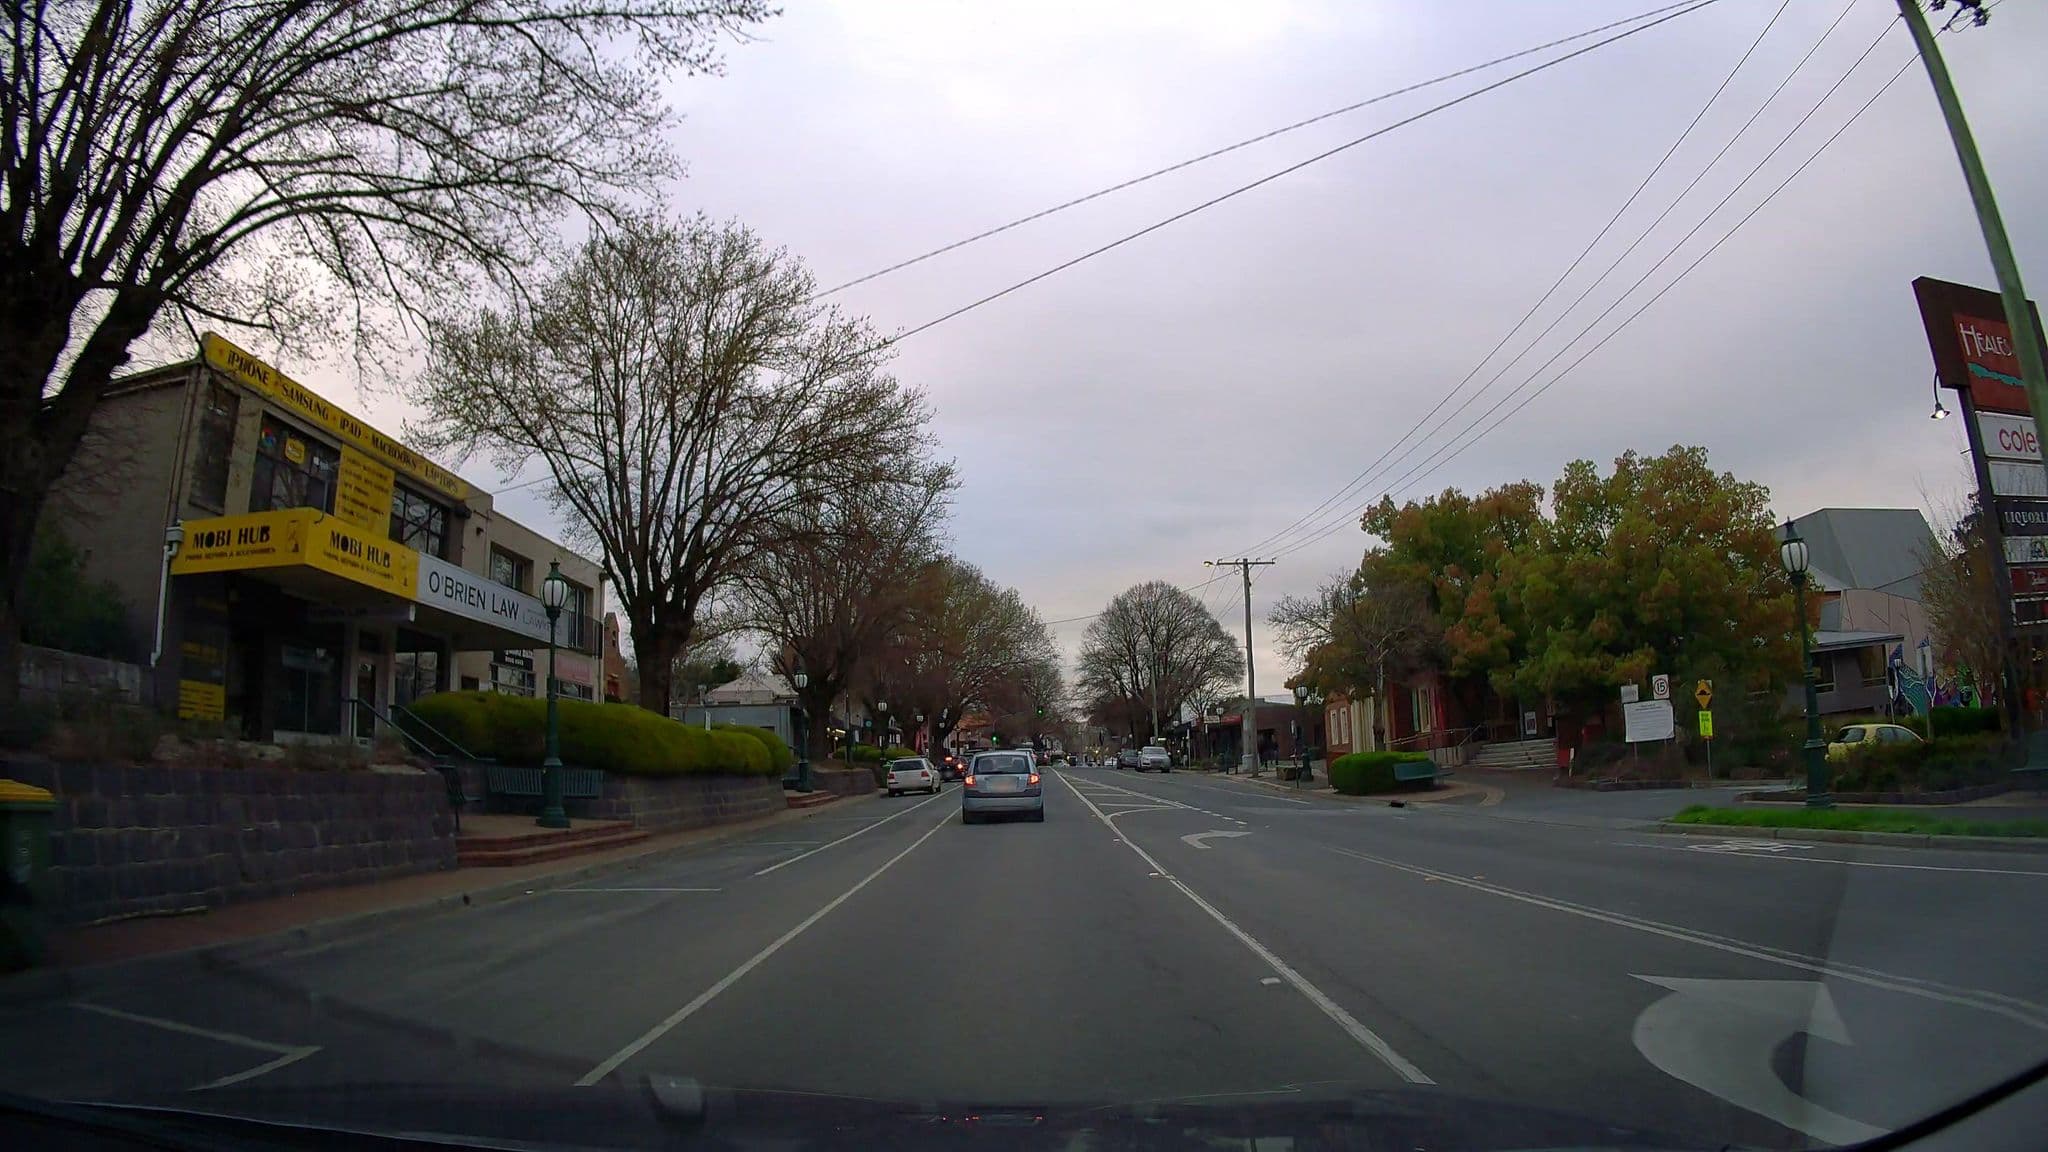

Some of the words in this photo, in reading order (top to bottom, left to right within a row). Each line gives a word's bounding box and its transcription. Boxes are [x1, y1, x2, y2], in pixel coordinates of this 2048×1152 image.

[1960, 323, 2013, 357] HEALES
[281, 383, 329, 421] SAMSUNG
[193, 529, 232, 549] MOBI
[238, 525, 271, 545] HUB
[330, 530, 362, 558] MOBI
[367, 544, 391, 569] HUB
[429, 571, 486, 610] O'BRIEN
[492, 593, 520, 620] LAW
[1656, 681, 1665, 693] 15
